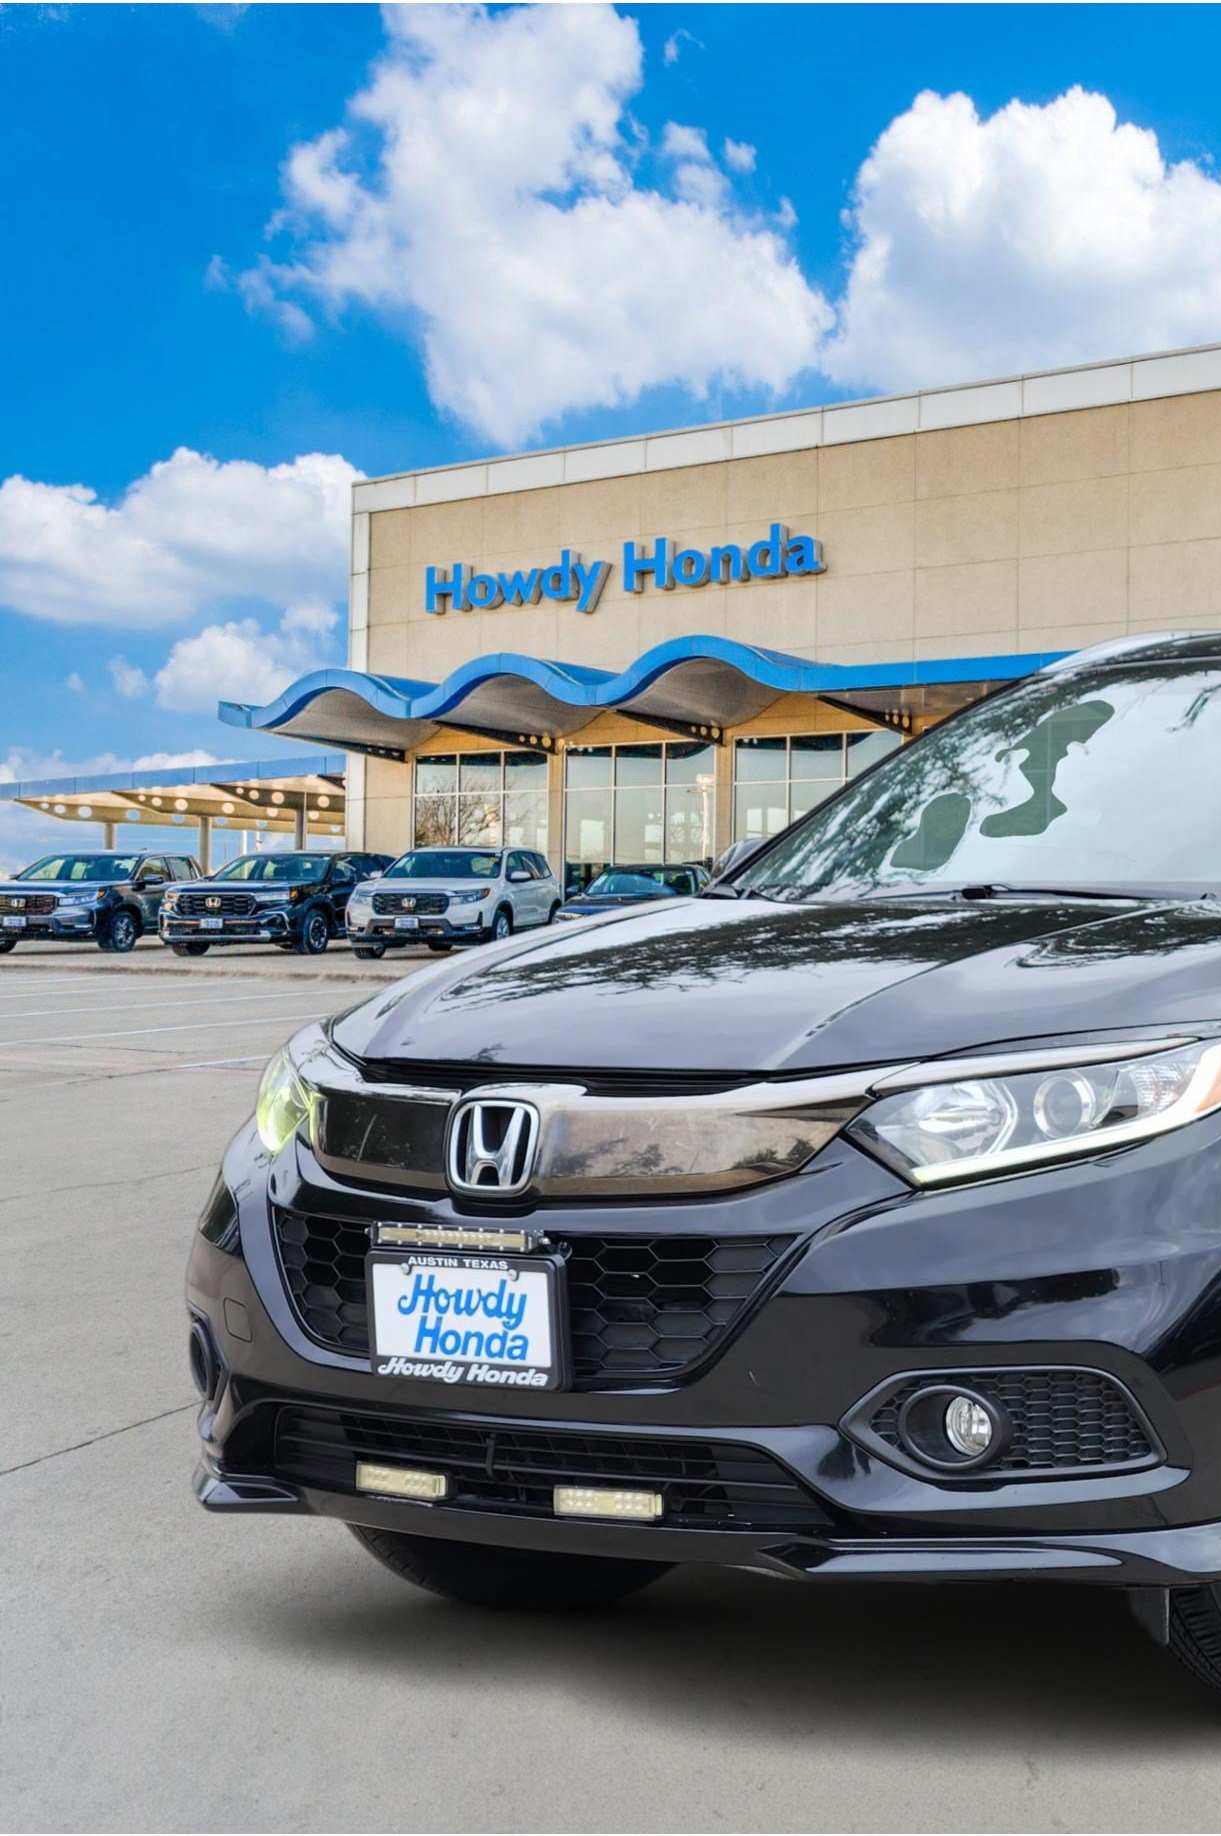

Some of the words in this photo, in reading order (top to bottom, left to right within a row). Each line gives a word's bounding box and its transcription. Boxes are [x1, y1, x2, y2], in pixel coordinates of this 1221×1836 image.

[425, 549, 610, 614] Howdy
[623, 523, 825, 593] Honda
[408, 1256, 458, 1268] AUSTIN
[463, 1259, 508, 1270] TEXAS
[398, 1274, 527, 1330] Howdy
[414, 1316, 529, 1361] Honda
[378, 1357, 465, 1383] Howdy
[467, 1364, 548, 1387] Honda
